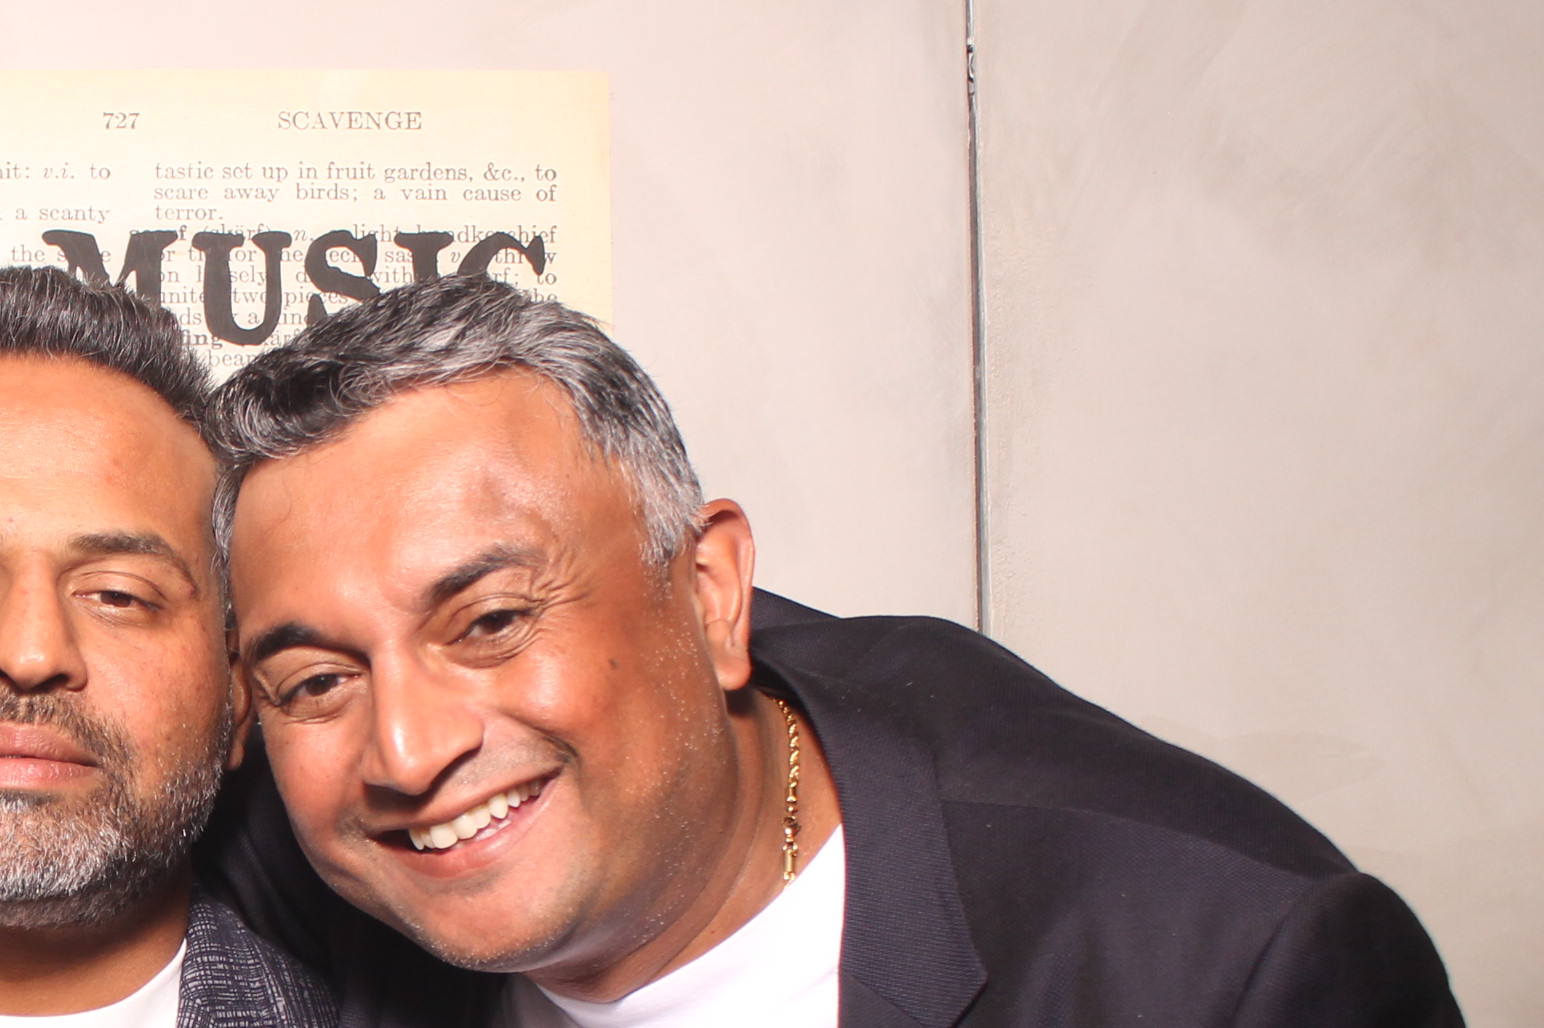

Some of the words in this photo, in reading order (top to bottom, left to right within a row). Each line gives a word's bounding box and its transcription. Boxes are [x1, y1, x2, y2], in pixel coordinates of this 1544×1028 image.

[102, 111, 140, 130] 727
[277, 110, 422, 130] SCAVENGE
[43, 162, 75, 180] v.i.
[90, 165, 112, 180] to
[155, 161, 214, 180] tastic
[221, 162, 253, 180] set
[262, 166, 288, 182] up
[297, 161, 318, 180] in
[326, 161, 376, 180] fruit
[383, 161, 474, 184] gardens,
[483, 162, 526, 183] &c.,
[535, 163, 557, 181] to
[153, 187, 208, 200] scare
[223, 187, 280, 202] away
[295, 182, 359, 201] birds;
[373, 187, 386, 201] a
[400, 183, 448, 201] vain
[462, 188, 522, 202] cause
[535, 184, 557, 202] of
[15, 208, 28, 221] a
[39, 204, 111, 224] scanty
[154, 203, 223, 221] terror.
[11, 244, 45, 262] the
